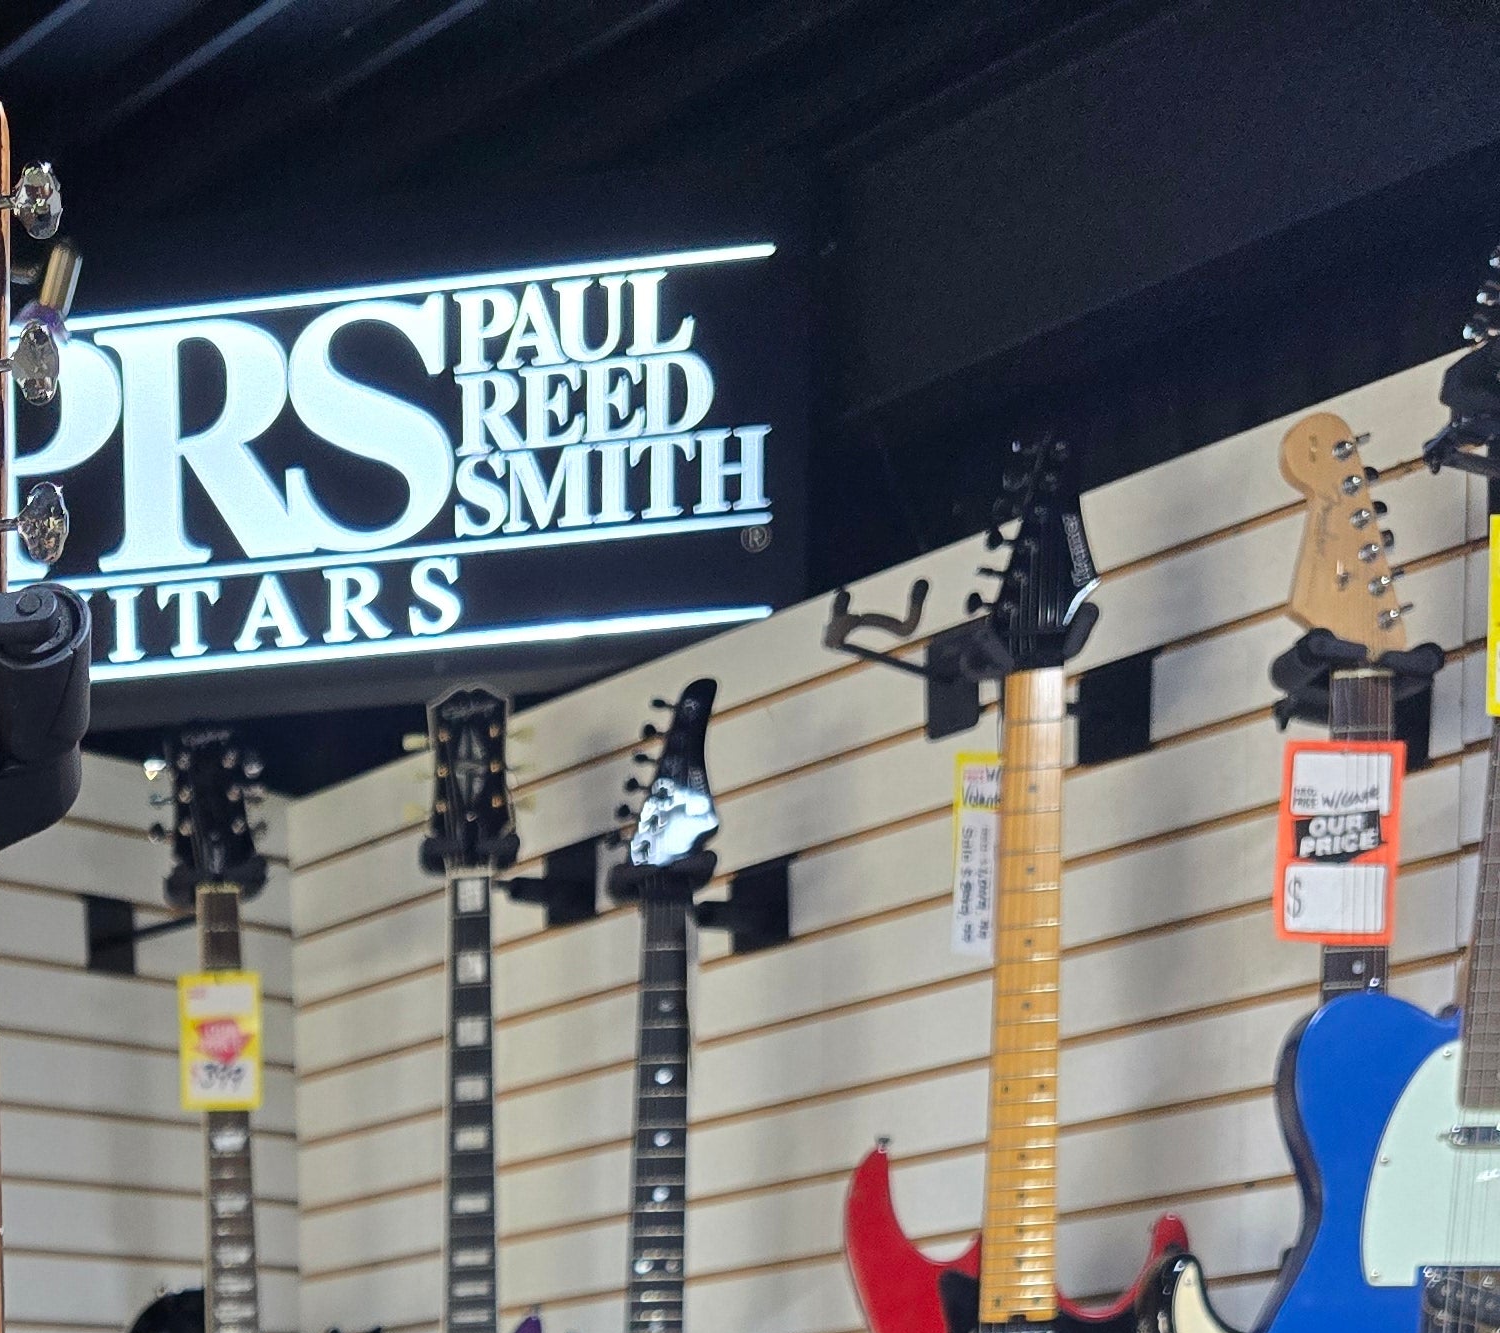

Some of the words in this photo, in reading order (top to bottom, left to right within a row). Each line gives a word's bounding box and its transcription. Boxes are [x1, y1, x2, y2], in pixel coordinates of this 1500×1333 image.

[455, 269, 696, 374] PAUL
[8, 291, 456, 580] PRS
[456, 351, 716, 458] REED
[454, 422, 773, 540] SMITH
[90, 556, 462, 664] ITARS
[1299, 826, 1381, 859] PRICE
[1308, 812, 1370, 838] OUR
